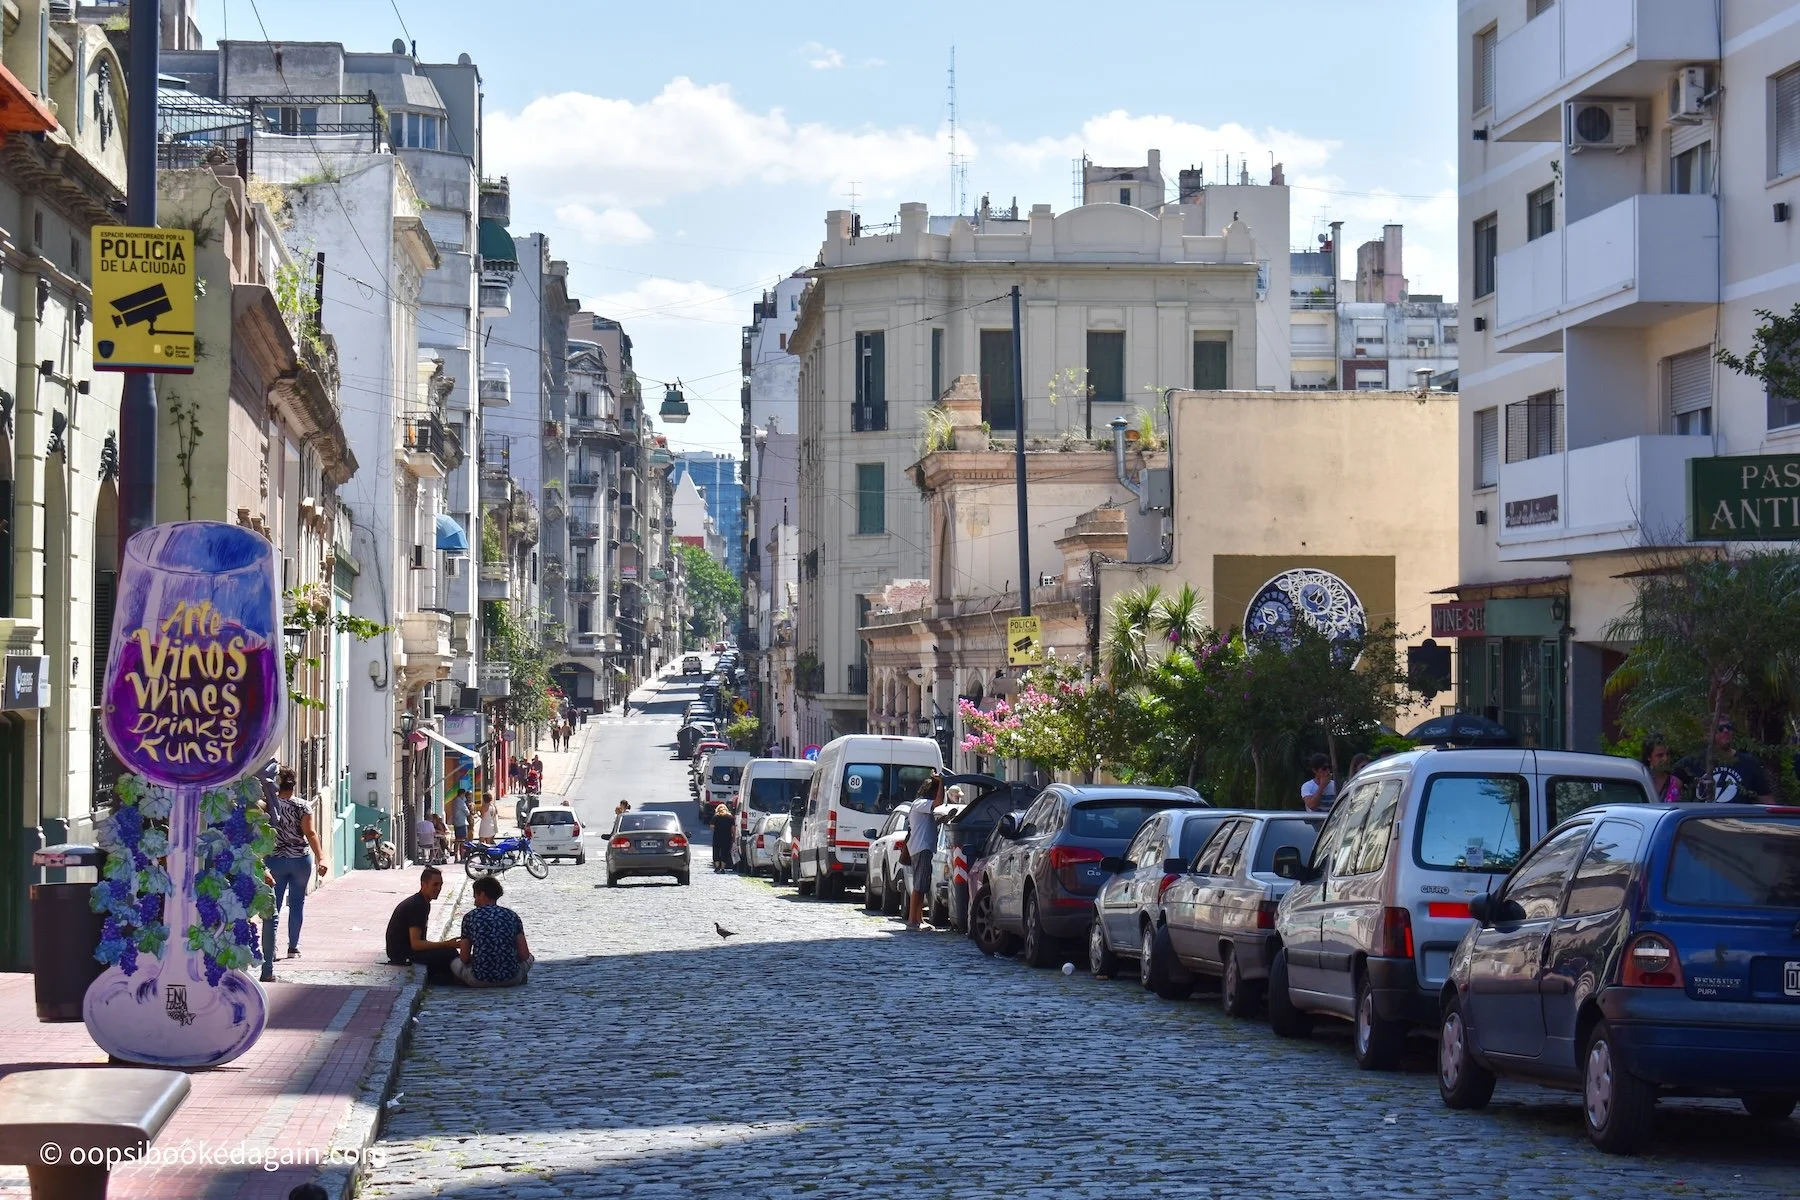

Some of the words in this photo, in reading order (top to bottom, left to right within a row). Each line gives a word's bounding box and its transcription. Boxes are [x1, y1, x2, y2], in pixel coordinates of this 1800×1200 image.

[101, 239, 185, 261] POLICIA
[101, 259, 118, 272] DE
[122, 260, 138, 273] LA
[141, 261, 186, 275] CIUDAD
[1741, 463, 1800, 490] PAS
[1710, 496, 1800, 530] ANTI
[160, 599, 222, 637] Arte
[1010, 621, 1037, 629] POLICIA
[1433, 608, 1464, 632] WINE
[132, 628, 247, 681] Vinos
[125, 672, 242, 719] Wines
[128, 713, 239, 740] Drinks
[850, 778, 861, 787] 80
